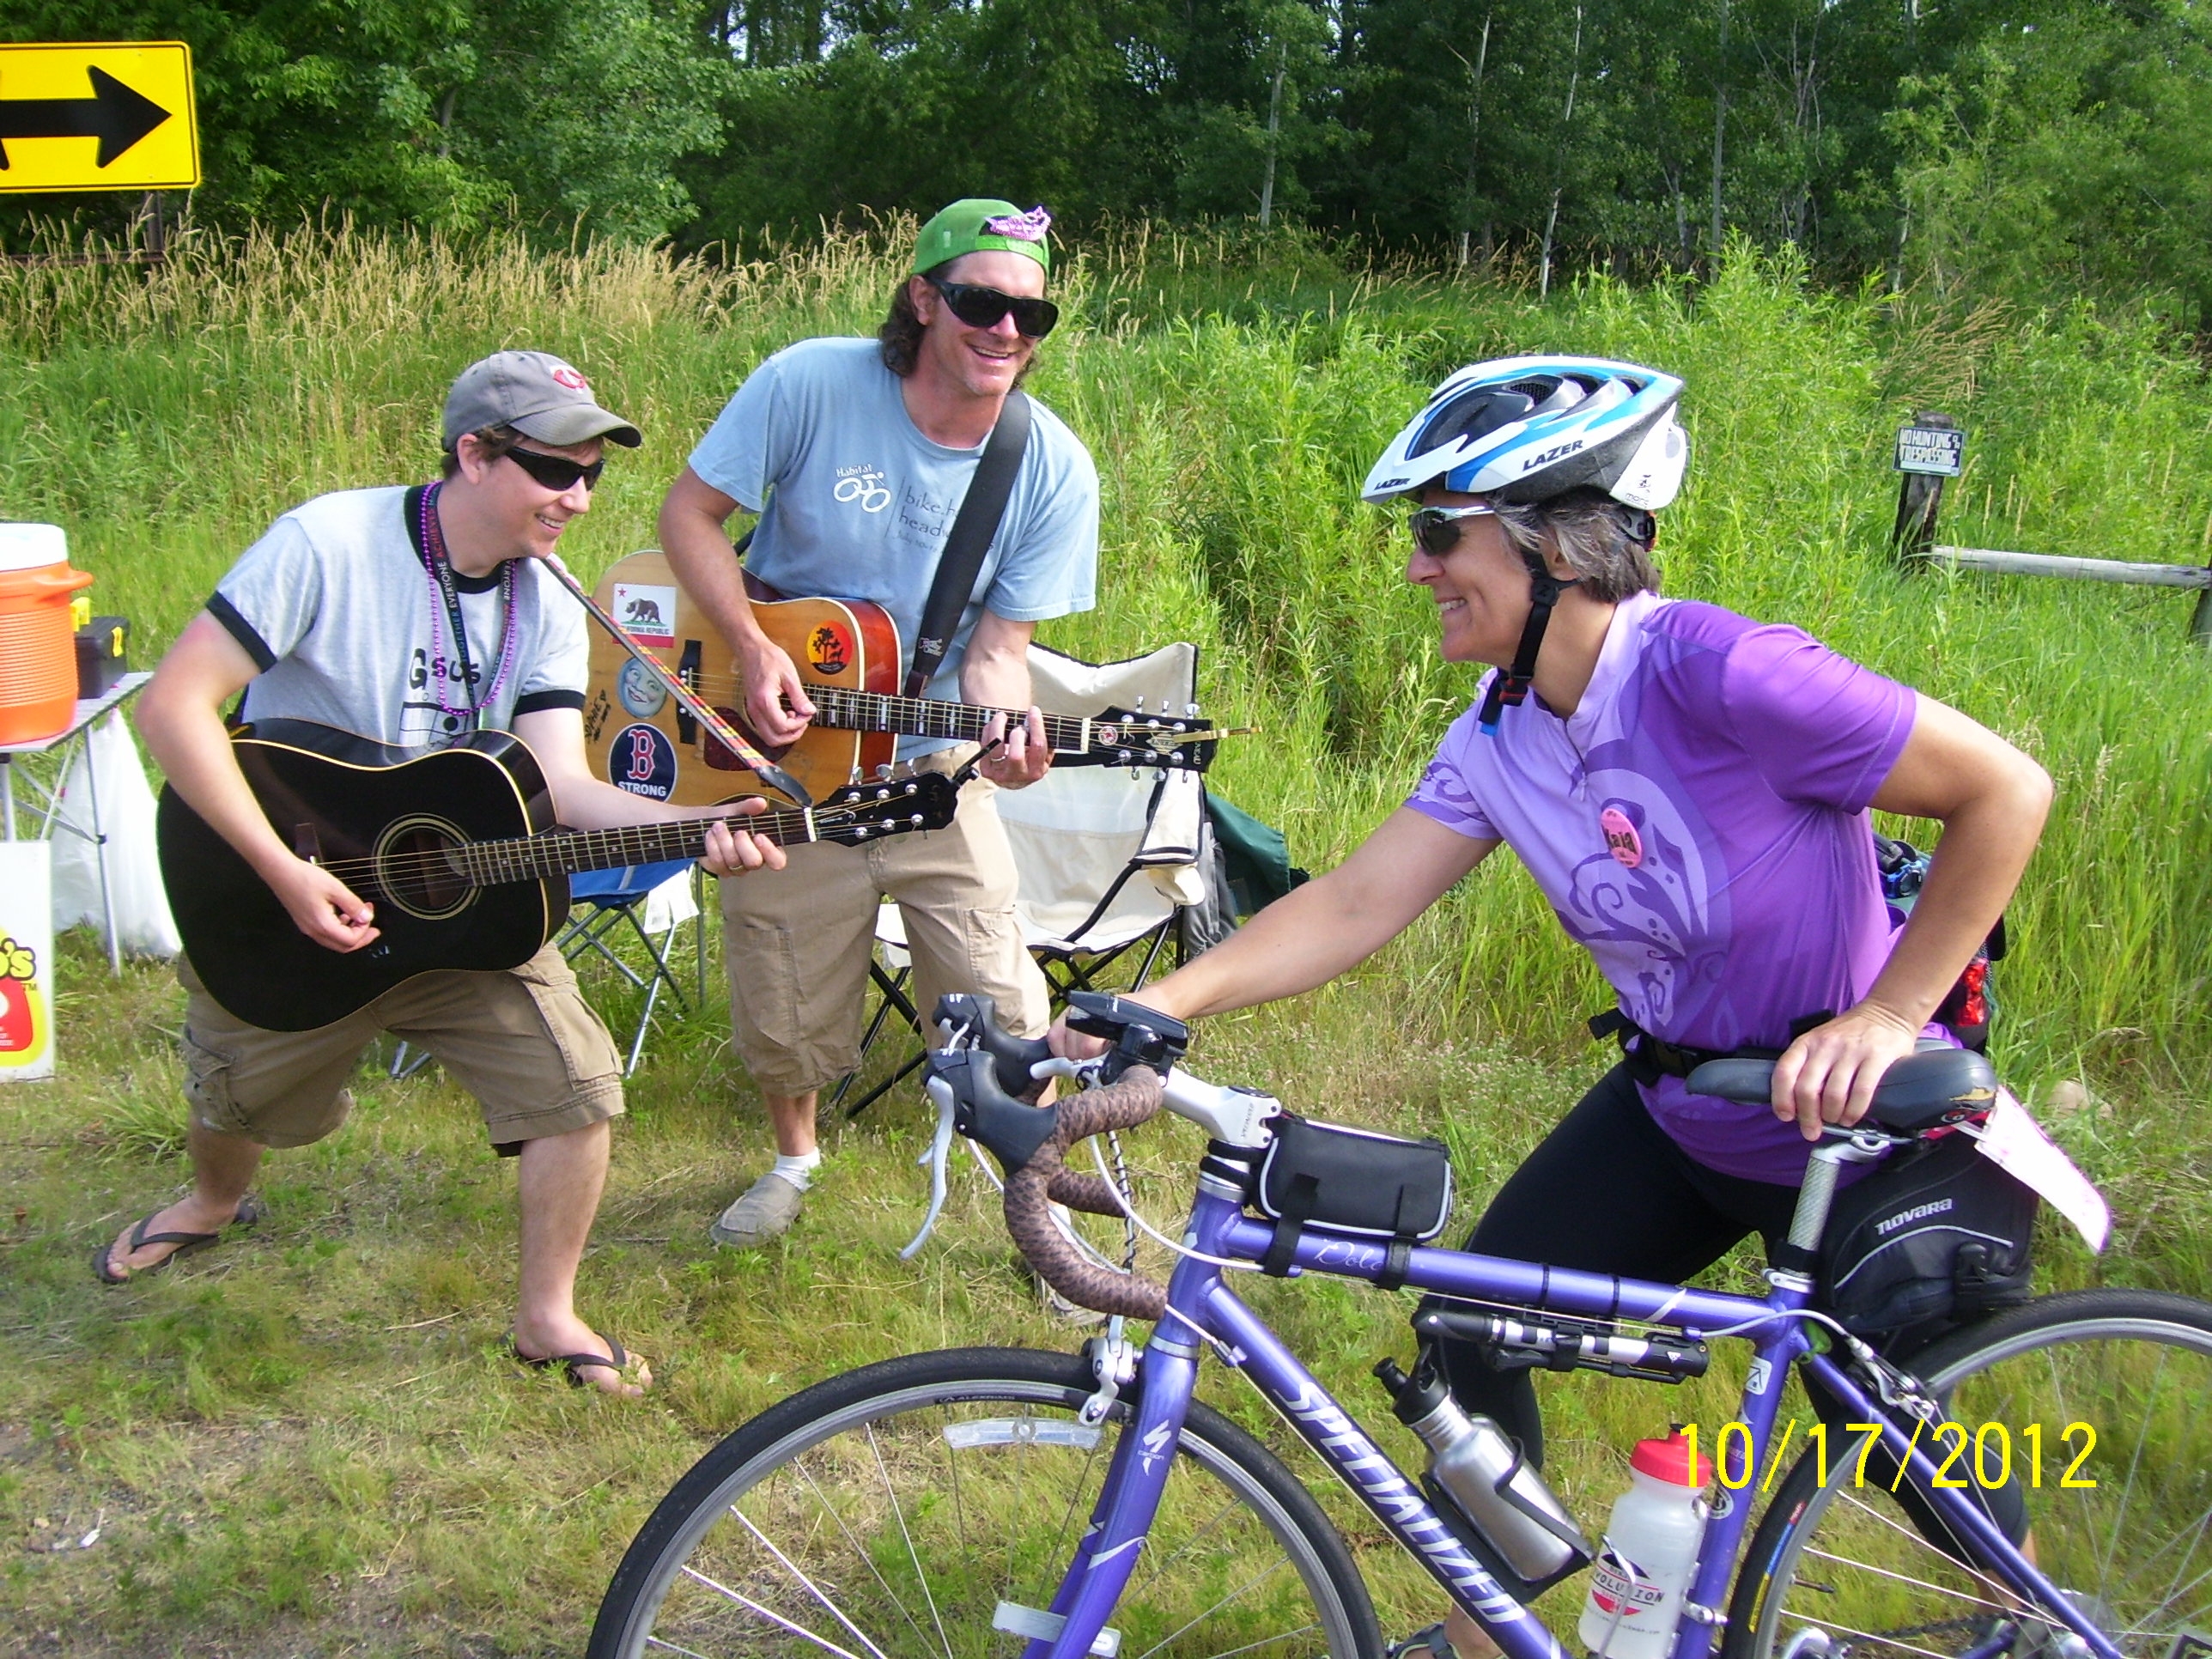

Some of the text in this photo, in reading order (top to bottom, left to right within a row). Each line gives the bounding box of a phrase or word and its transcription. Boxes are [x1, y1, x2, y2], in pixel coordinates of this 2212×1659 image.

[1899, 428, 1912, 445] NO
[1911, 429, 1952, 449] HUNTING
[1522, 439, 1583, 471] LAZER
[1899, 445, 1958, 466] TRESPASSING
[836, 463, 873, 478] Habitat
[1373, 477, 1411, 491] LAZER
[436, 562, 459, 609] EVERYONE
[626, 728, 656, 781] B
[617, 781, 667, 798] STRONG
[1273, 1382, 1527, 1623] SPECIALIZED
